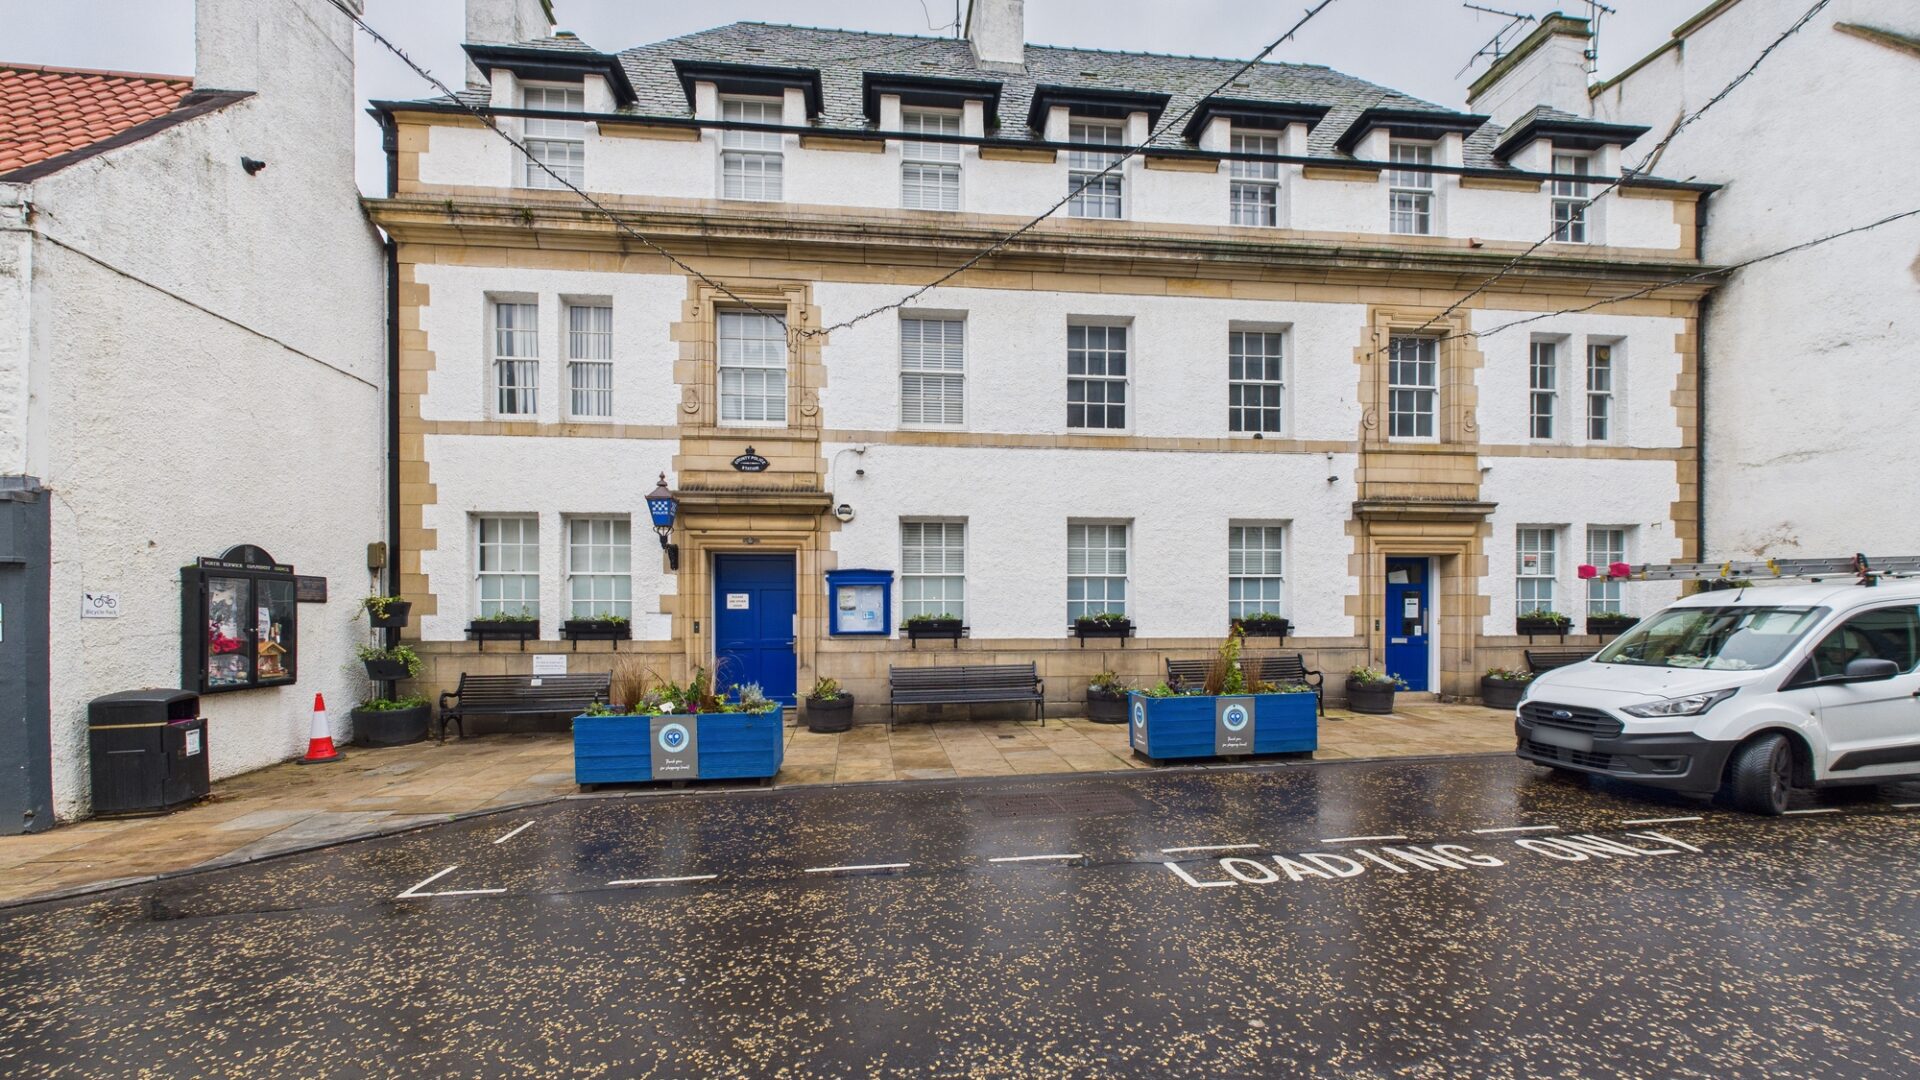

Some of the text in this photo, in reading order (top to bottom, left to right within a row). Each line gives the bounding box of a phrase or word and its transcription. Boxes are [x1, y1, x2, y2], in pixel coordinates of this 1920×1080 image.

[734, 456, 750, 465] COUNTY
[750, 456, 766, 465] POLICE
[222, 561, 243, 569] BERWICK
[1163, 832, 1701, 888] LOADING ONLY
